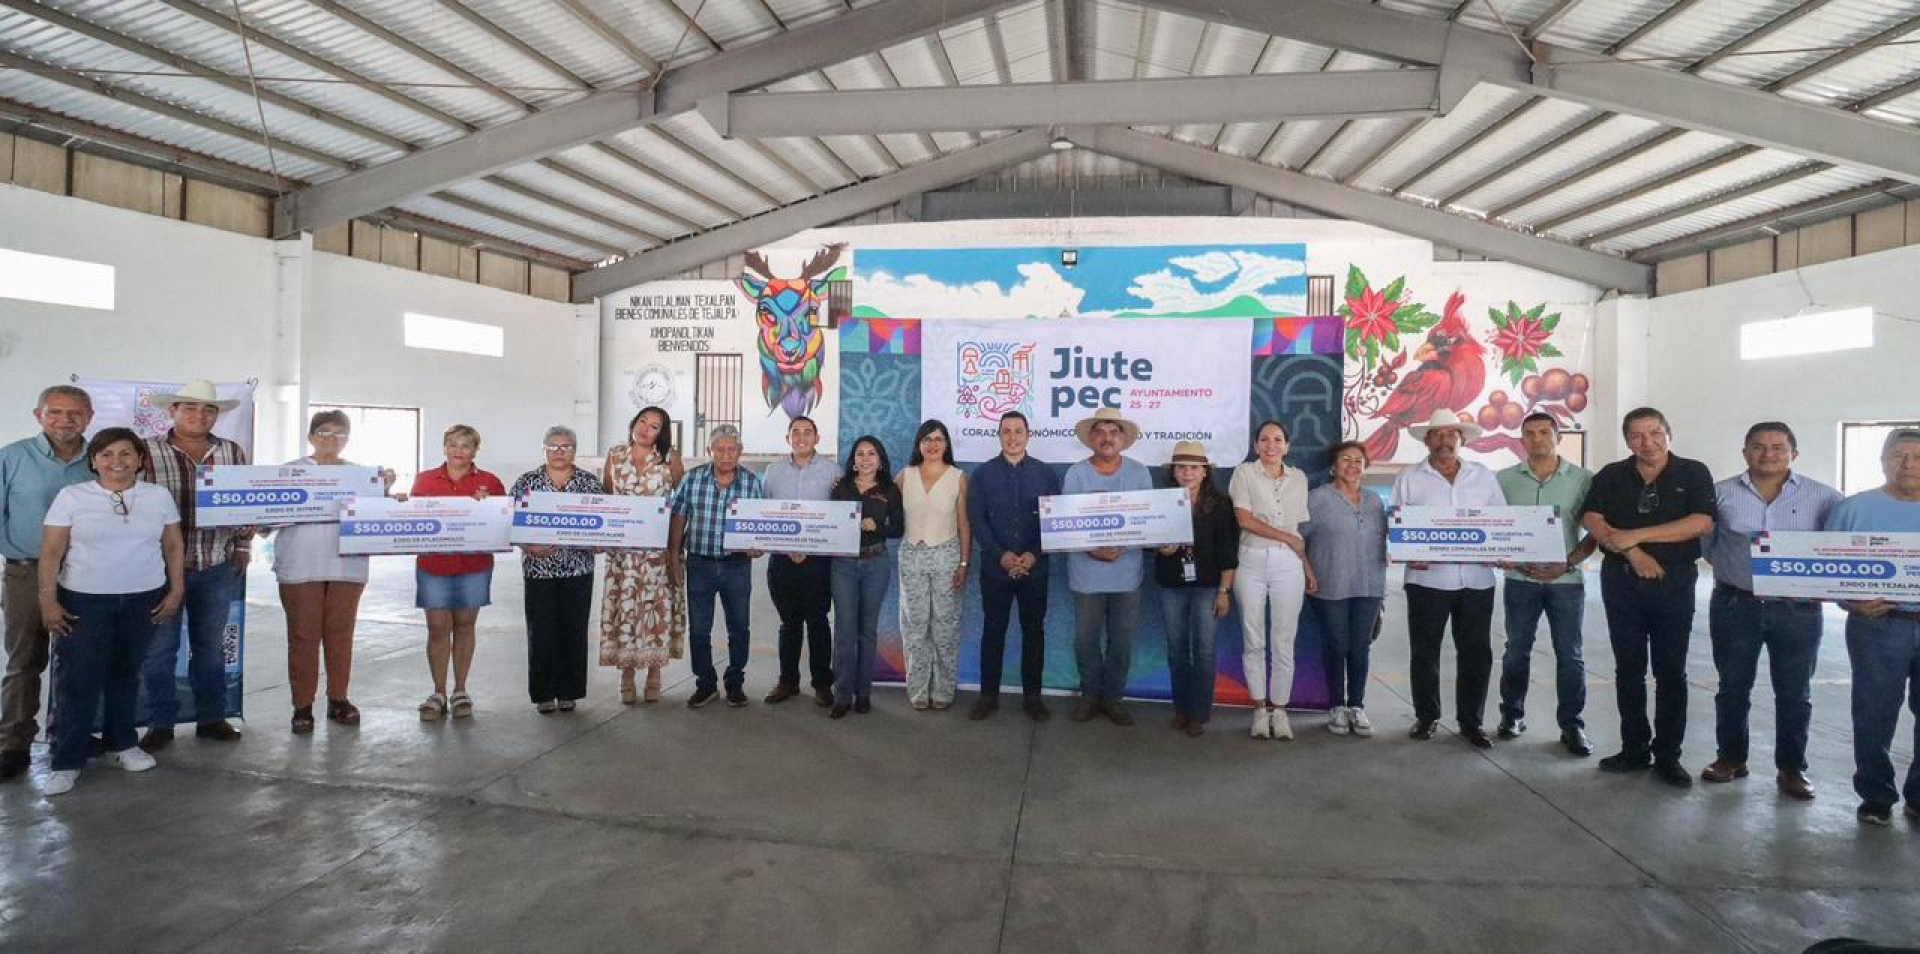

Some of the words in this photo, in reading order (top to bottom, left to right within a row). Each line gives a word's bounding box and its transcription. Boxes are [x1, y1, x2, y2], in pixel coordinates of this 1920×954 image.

[629, 295, 651, 306] NIKAN
[694, 294, 736, 306] TEXALPAN
[615, 308, 643, 320] BIENES
[644, 308, 688, 320] COMUNALES
[689, 308, 700, 320] DE
[702, 308, 737, 320] TEJALPA
[658, 340, 710, 351] BIENVENIDOS
[1050, 345, 1153, 381] Jiute
[1129, 388, 1213, 397] AYUNTAMIENTO
[1050, 383, 1122, 417] pec
[1129, 400, 1142, 409] 25
[1148, 401, 1161, 409] 27
[962, 428, 1000, 438] CORAZ
[1029, 427, 1076, 438] ONÓMICO
[1145, 431, 1152, 440] Y
[1153, 429, 1212, 440] TRADICIÓN
[211, 491, 301, 505] $50,000.00
[526, 514, 598, 527] $50,000.00
[735, 521, 796, 532] $50,000.00
[1051, 517, 1120, 530] $50,000.00
[354, 522, 435, 534] $50,000.00
[1402, 530, 1480, 542] $50,000.00
[1769, 560, 1885, 575] $50,000.00
